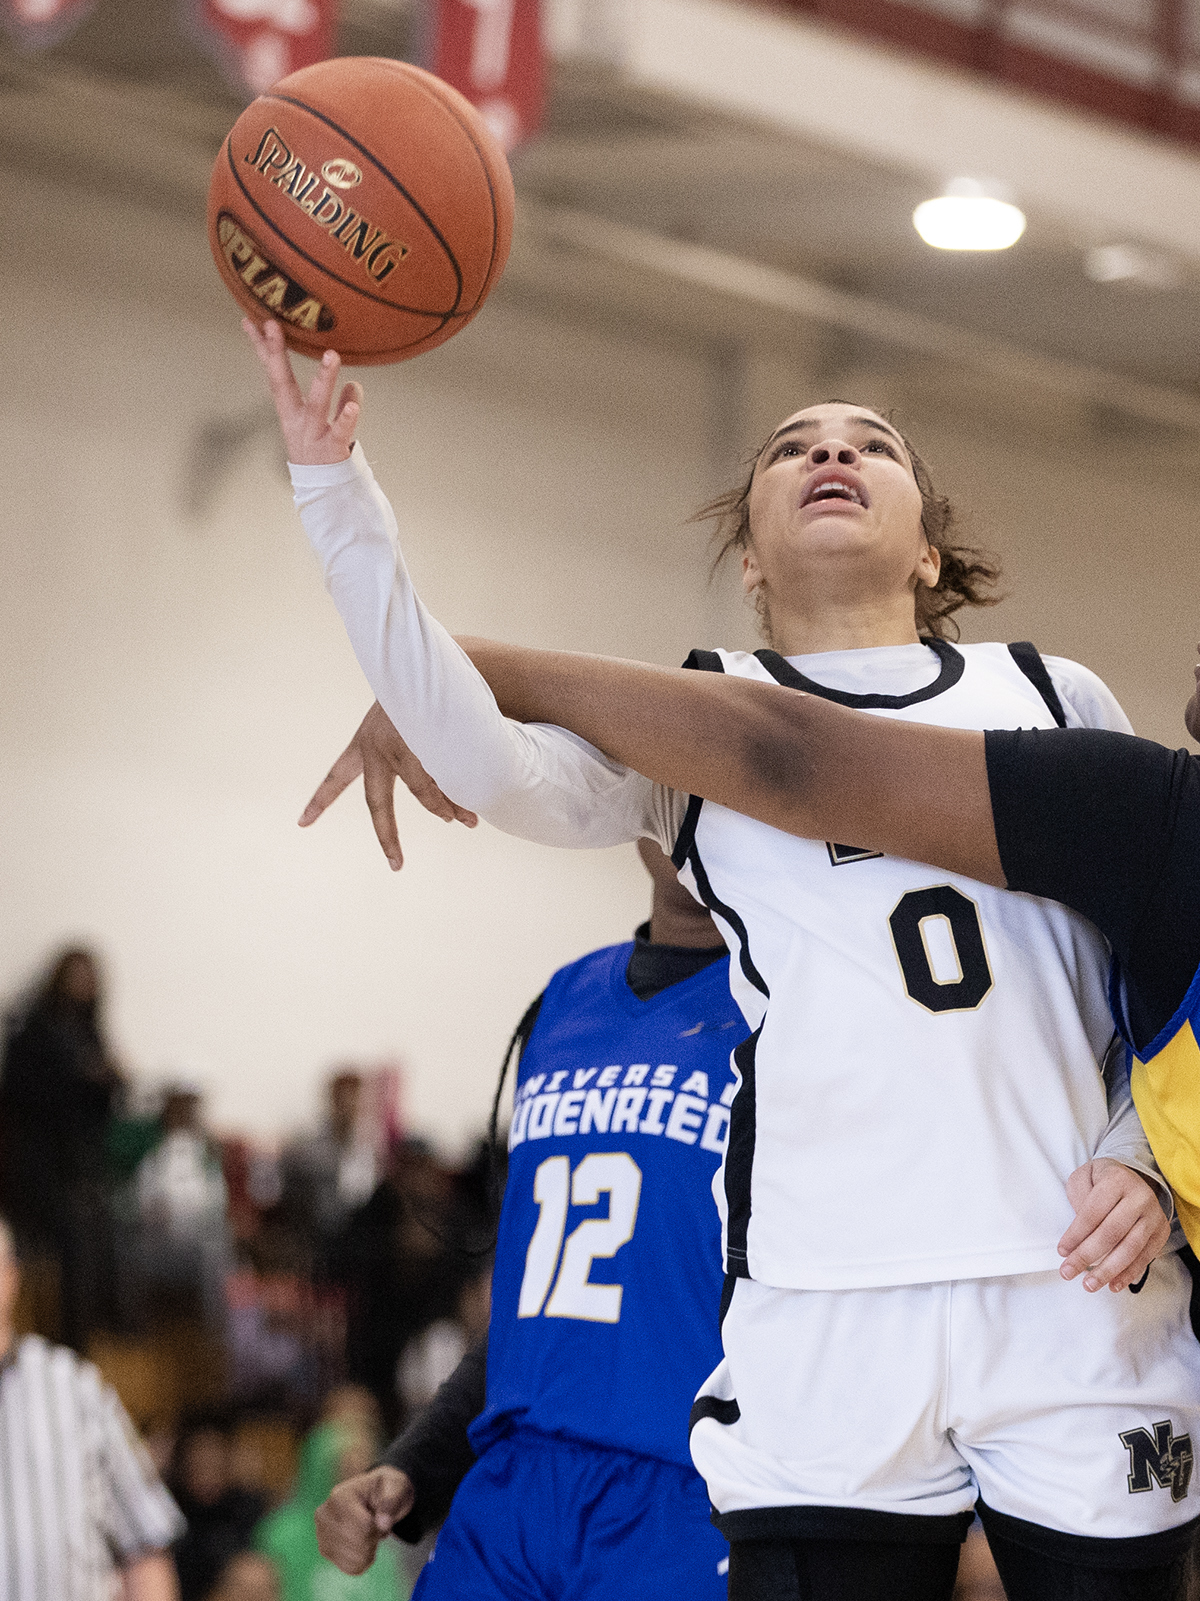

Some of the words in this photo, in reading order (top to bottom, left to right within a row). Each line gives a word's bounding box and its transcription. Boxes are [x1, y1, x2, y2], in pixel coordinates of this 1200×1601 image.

[243, 125, 408, 288] SPALDING
[219, 227, 322, 330] PIAA
[886, 881, 996, 1017] 0
[515, 1063, 734, 1107] NIVERSA
[517, 1152, 643, 1324] 12
